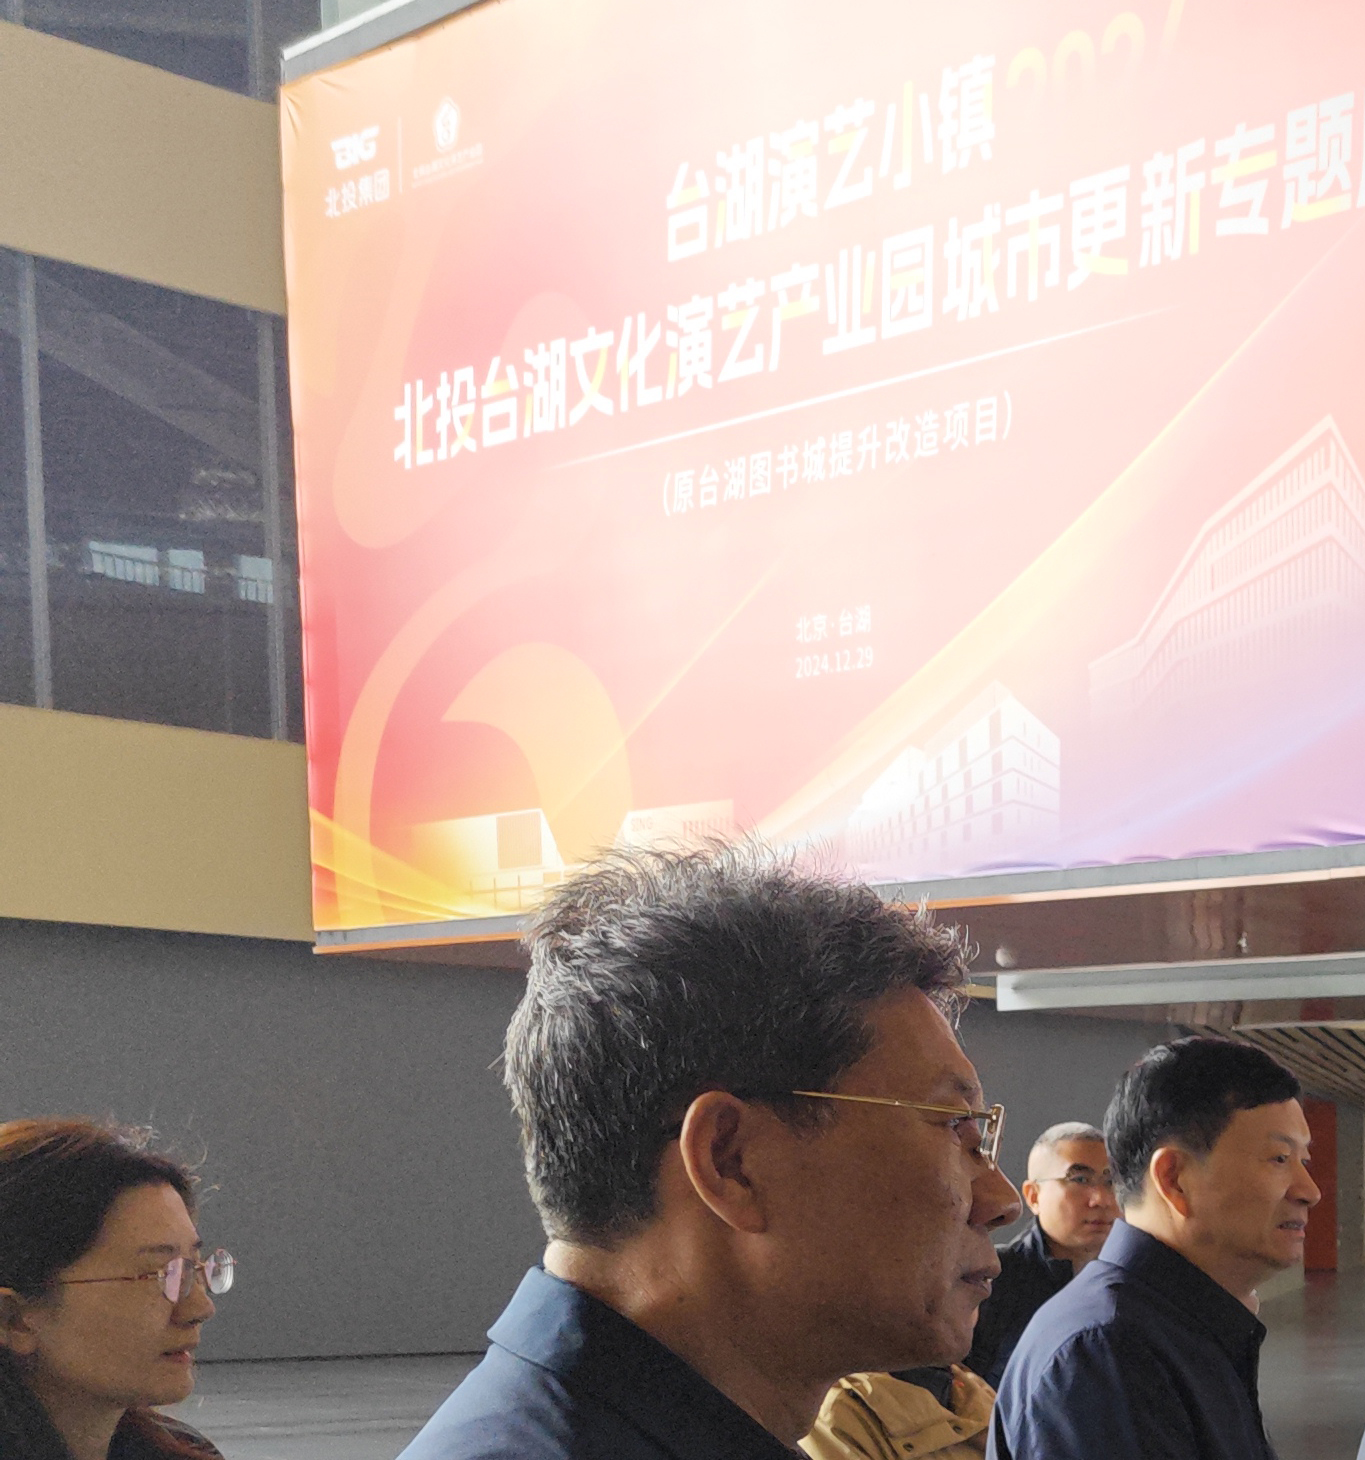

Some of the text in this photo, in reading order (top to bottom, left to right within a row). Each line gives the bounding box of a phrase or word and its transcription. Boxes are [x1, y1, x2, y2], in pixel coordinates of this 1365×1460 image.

[666, 54, 997, 263] 台湖演艺小镇
[324, 167, 391, 219] 北投集团
[794, 645, 874, 679] 2024.12.29
